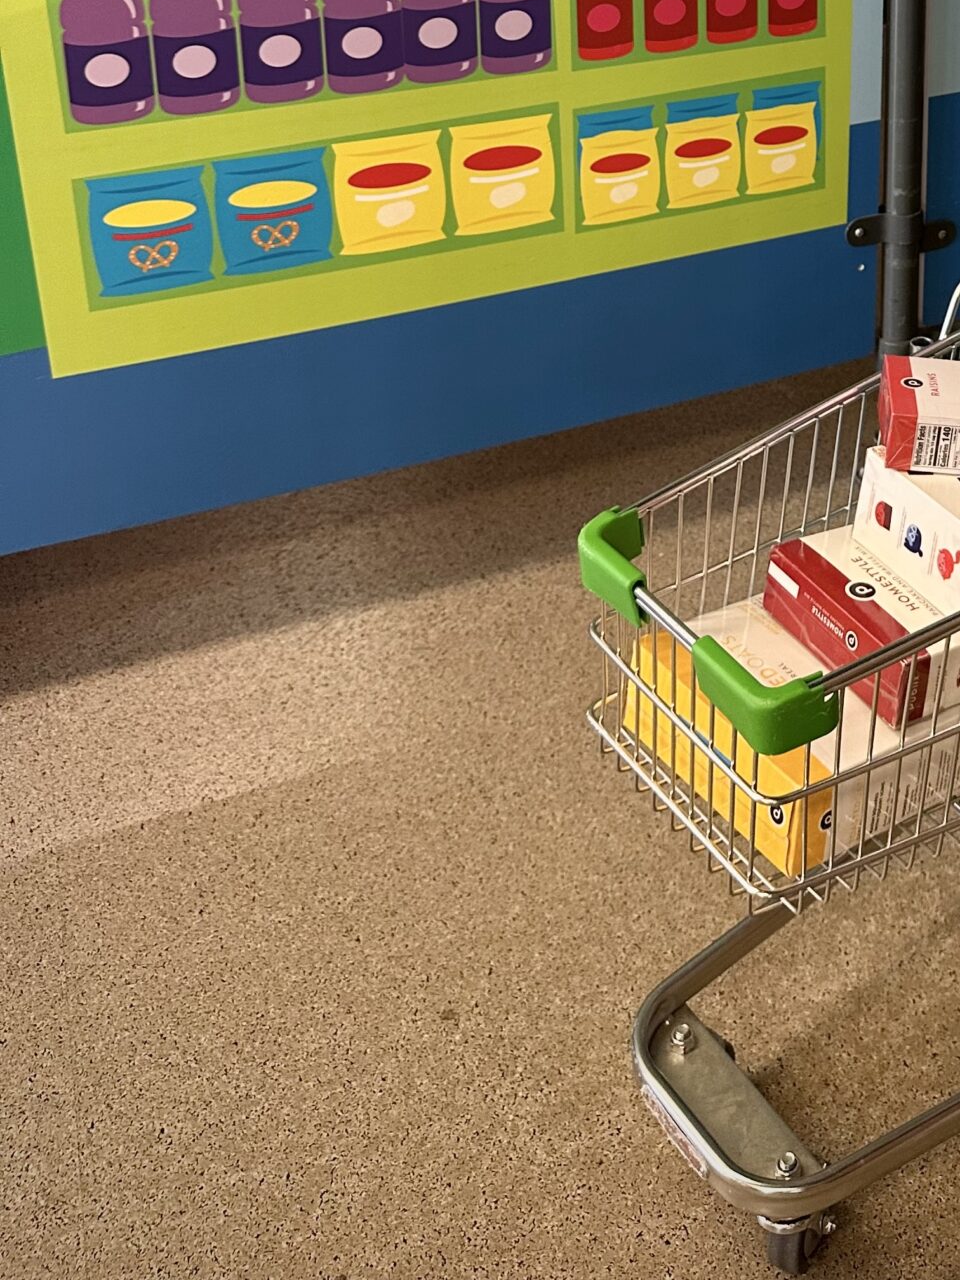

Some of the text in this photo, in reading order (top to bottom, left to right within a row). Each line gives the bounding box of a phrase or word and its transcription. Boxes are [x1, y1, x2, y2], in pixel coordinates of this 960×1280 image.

[927, 372, 940, 397] RAISINS
[914, 425, 926, 466] Nutrition Facts
[940, 426, 951, 467] Calories 140
[850, 555, 920, 612] HOMESTYLE
[811, 605, 844, 639] HOMESTYLE
